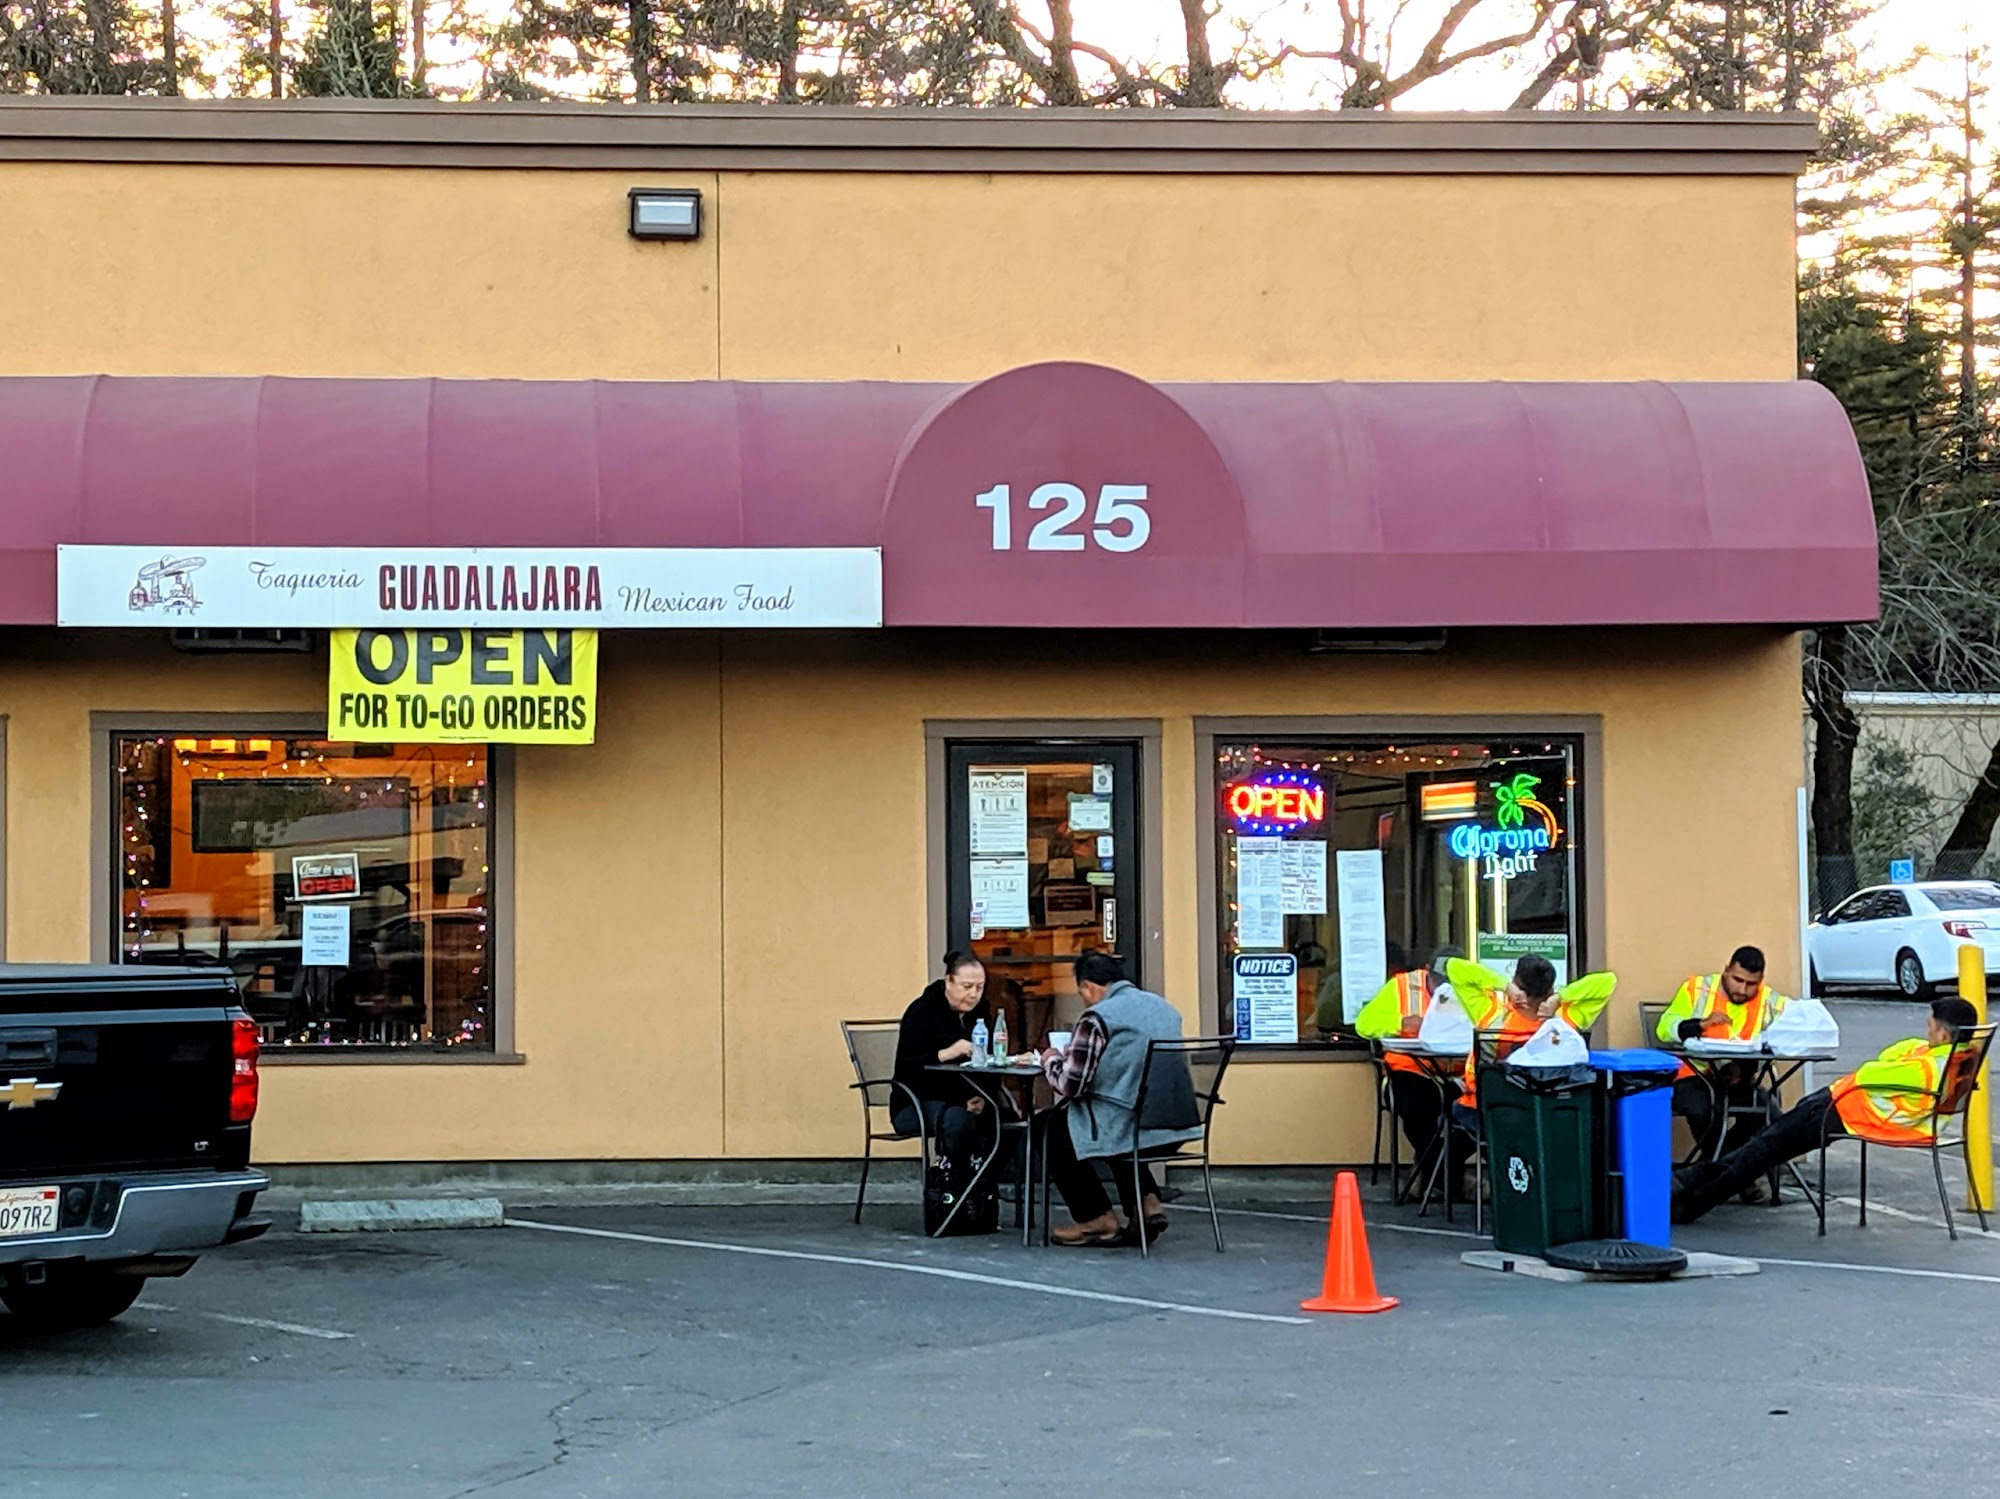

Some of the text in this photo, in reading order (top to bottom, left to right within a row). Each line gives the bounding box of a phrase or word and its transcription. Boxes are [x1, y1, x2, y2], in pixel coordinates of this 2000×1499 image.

[975, 482, 1151, 552] 125
[249, 560, 795, 612] Taqueria GUADALAJARA Mexican Food
[354, 629, 573, 686] OPEN
[339, 692, 587, 730] FOR TO-GO ORDERS
[1229, 785, 1325, 821] OPEN
[1451, 823, 1551, 859] Corona
[300, 876, 354, 894] OPEN
[1239, 959, 1292, 974] NOTICE
